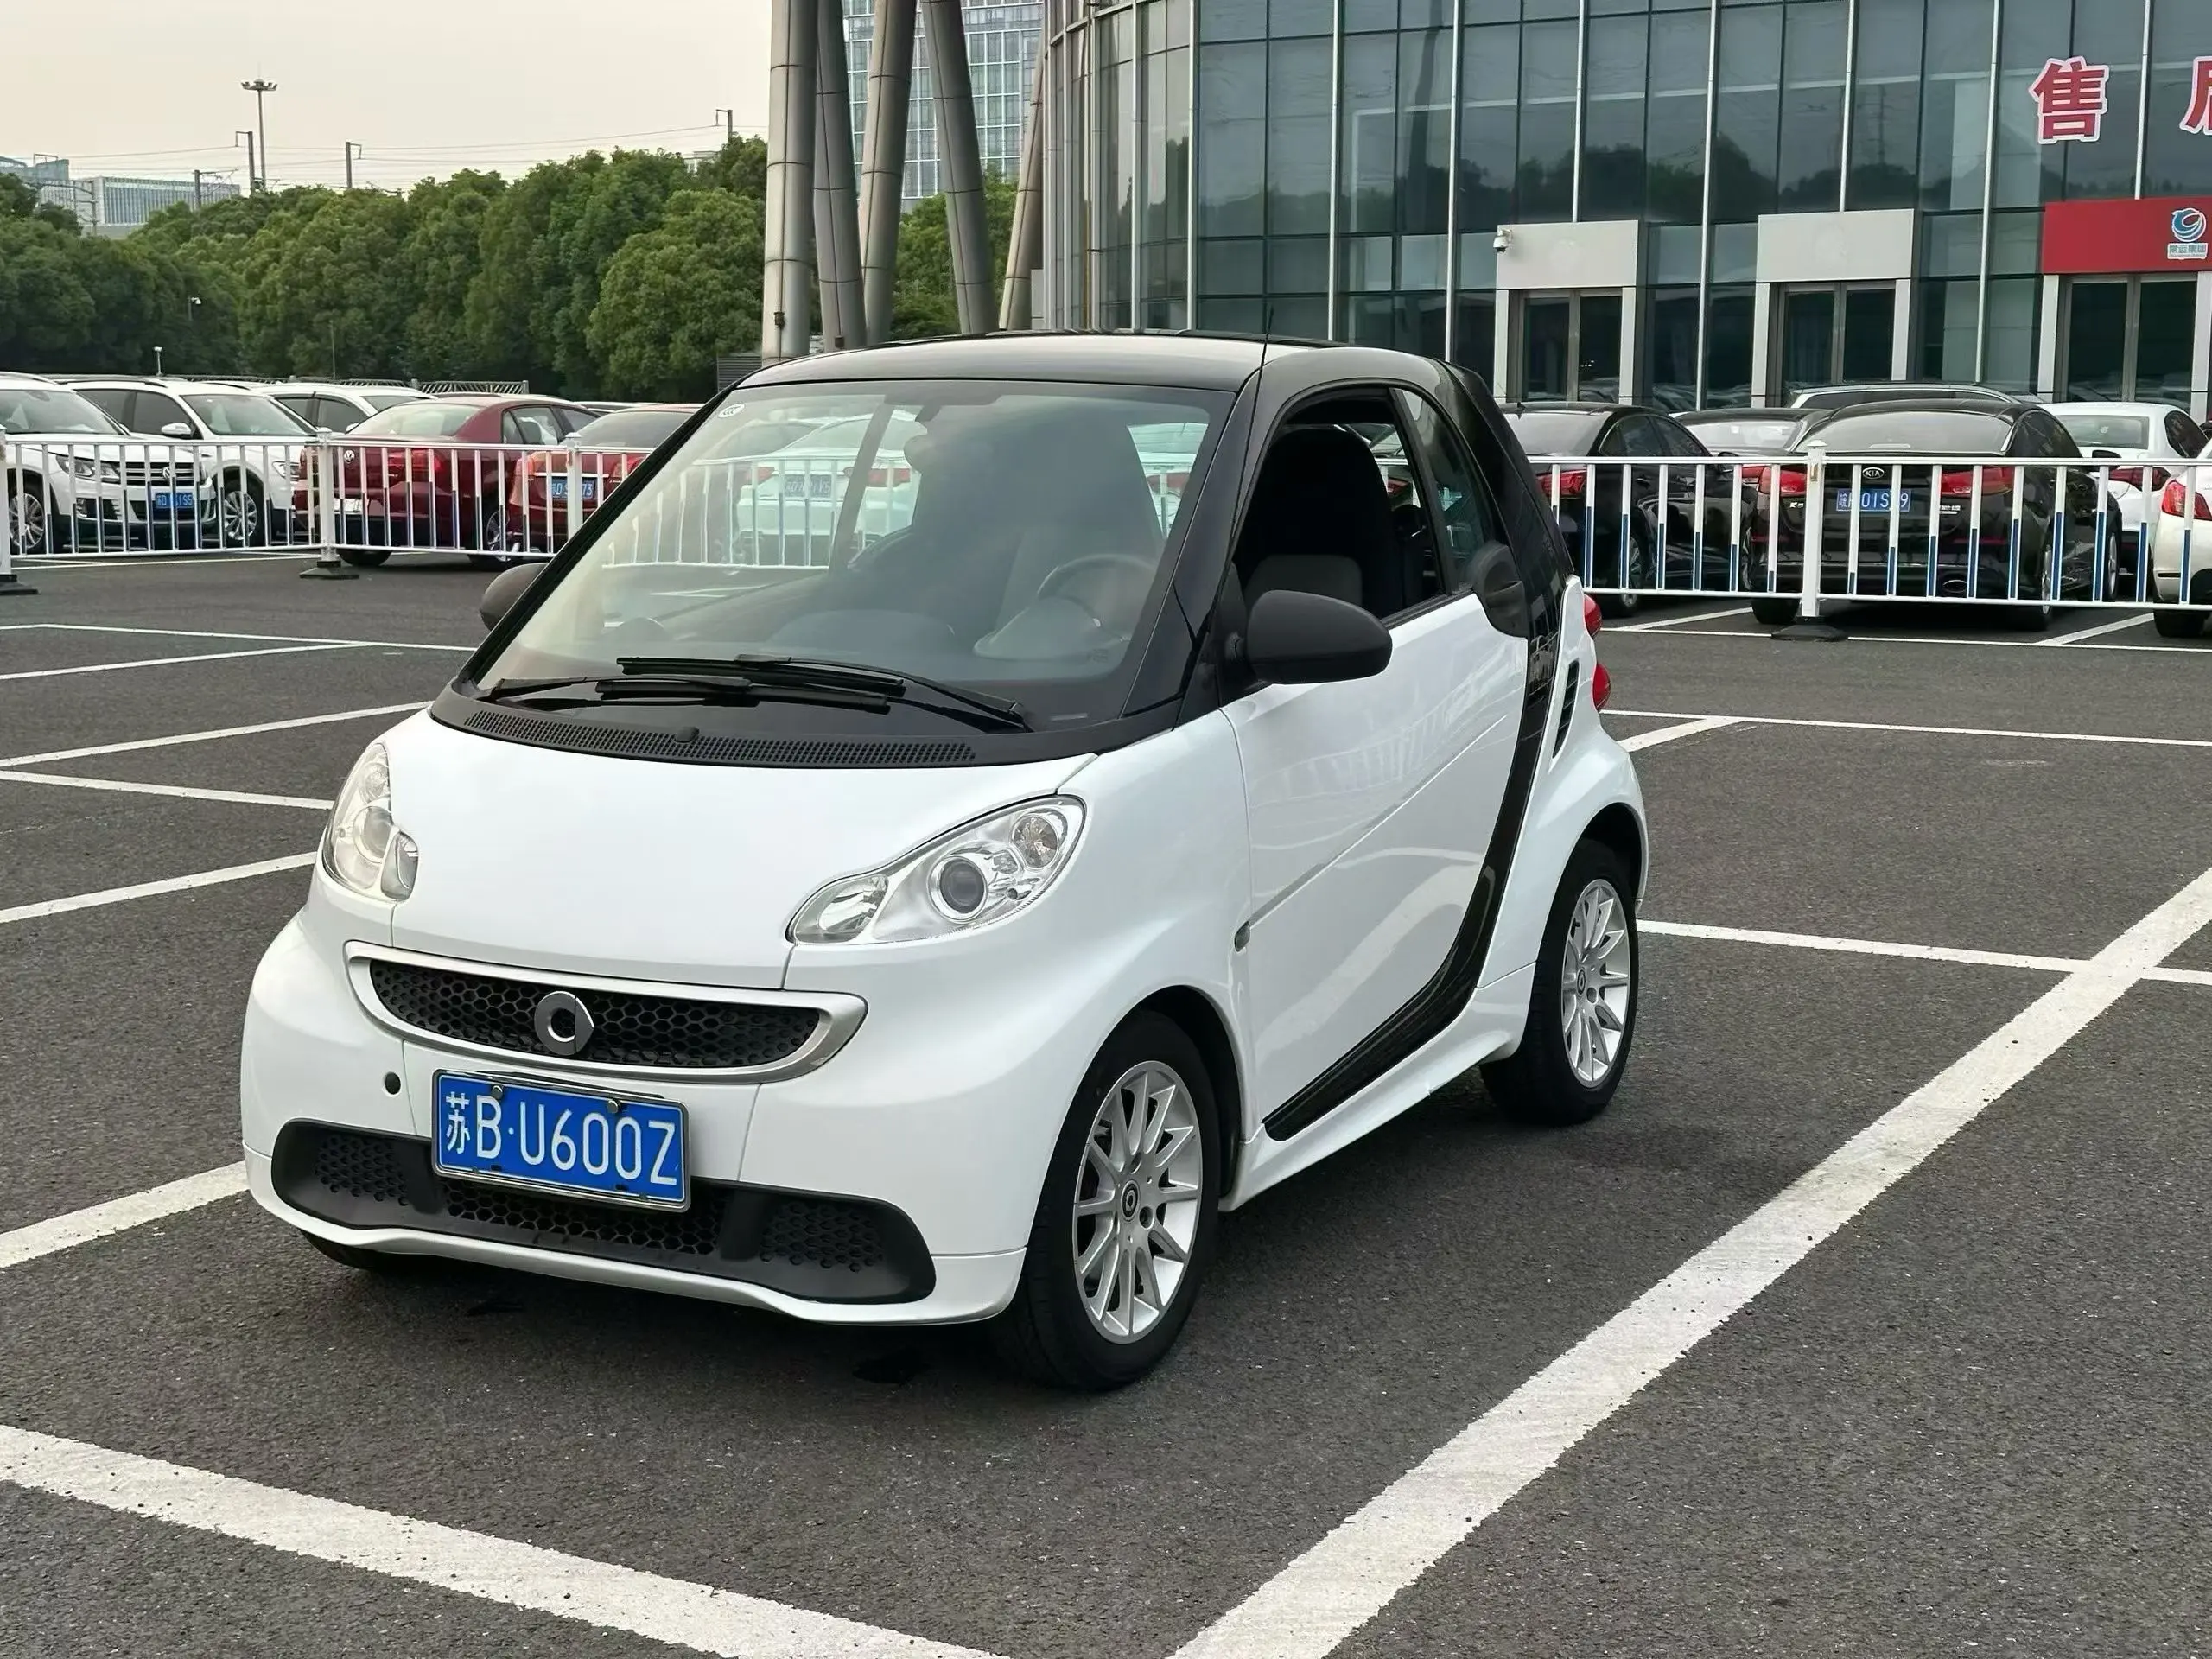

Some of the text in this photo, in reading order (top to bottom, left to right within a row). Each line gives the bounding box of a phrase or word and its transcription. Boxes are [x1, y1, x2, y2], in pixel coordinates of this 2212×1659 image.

[1864, 468, 1883, 478] KIA
[1839, 492, 1909, 508] 皖01S9
[446, 1092, 677, 1186] 苏B·U600Z
